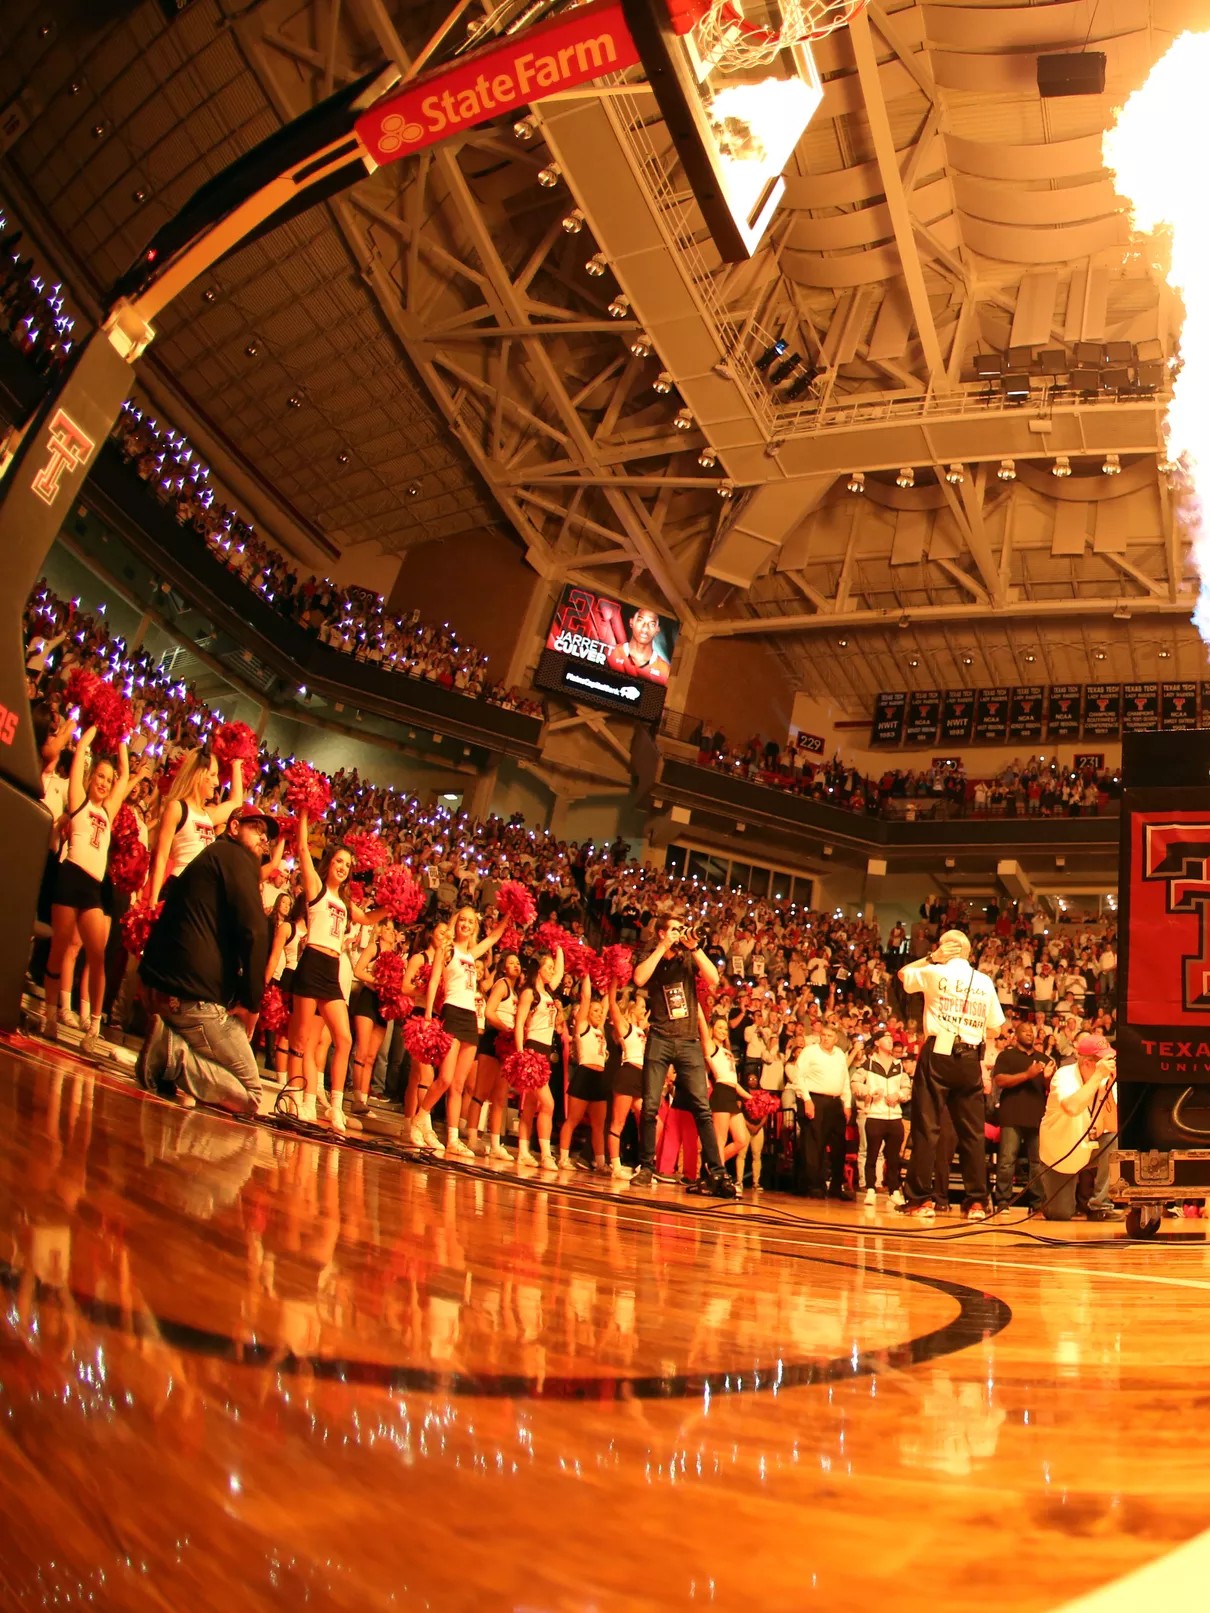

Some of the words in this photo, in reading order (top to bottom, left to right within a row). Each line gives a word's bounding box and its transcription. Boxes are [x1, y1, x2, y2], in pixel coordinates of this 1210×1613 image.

[556, 630, 616, 657] JARRETT
[554, 640, 607, 665] CULVER
[878, 721, 899, 730] NWIT
[946, 718, 968, 727] NWIT
[799, 735, 821, 751] 229
[1079, 756, 1099, 769] 231
[938, 1014, 962, 1025] EVENT
[963, 1017, 984, 1029] STAFF
